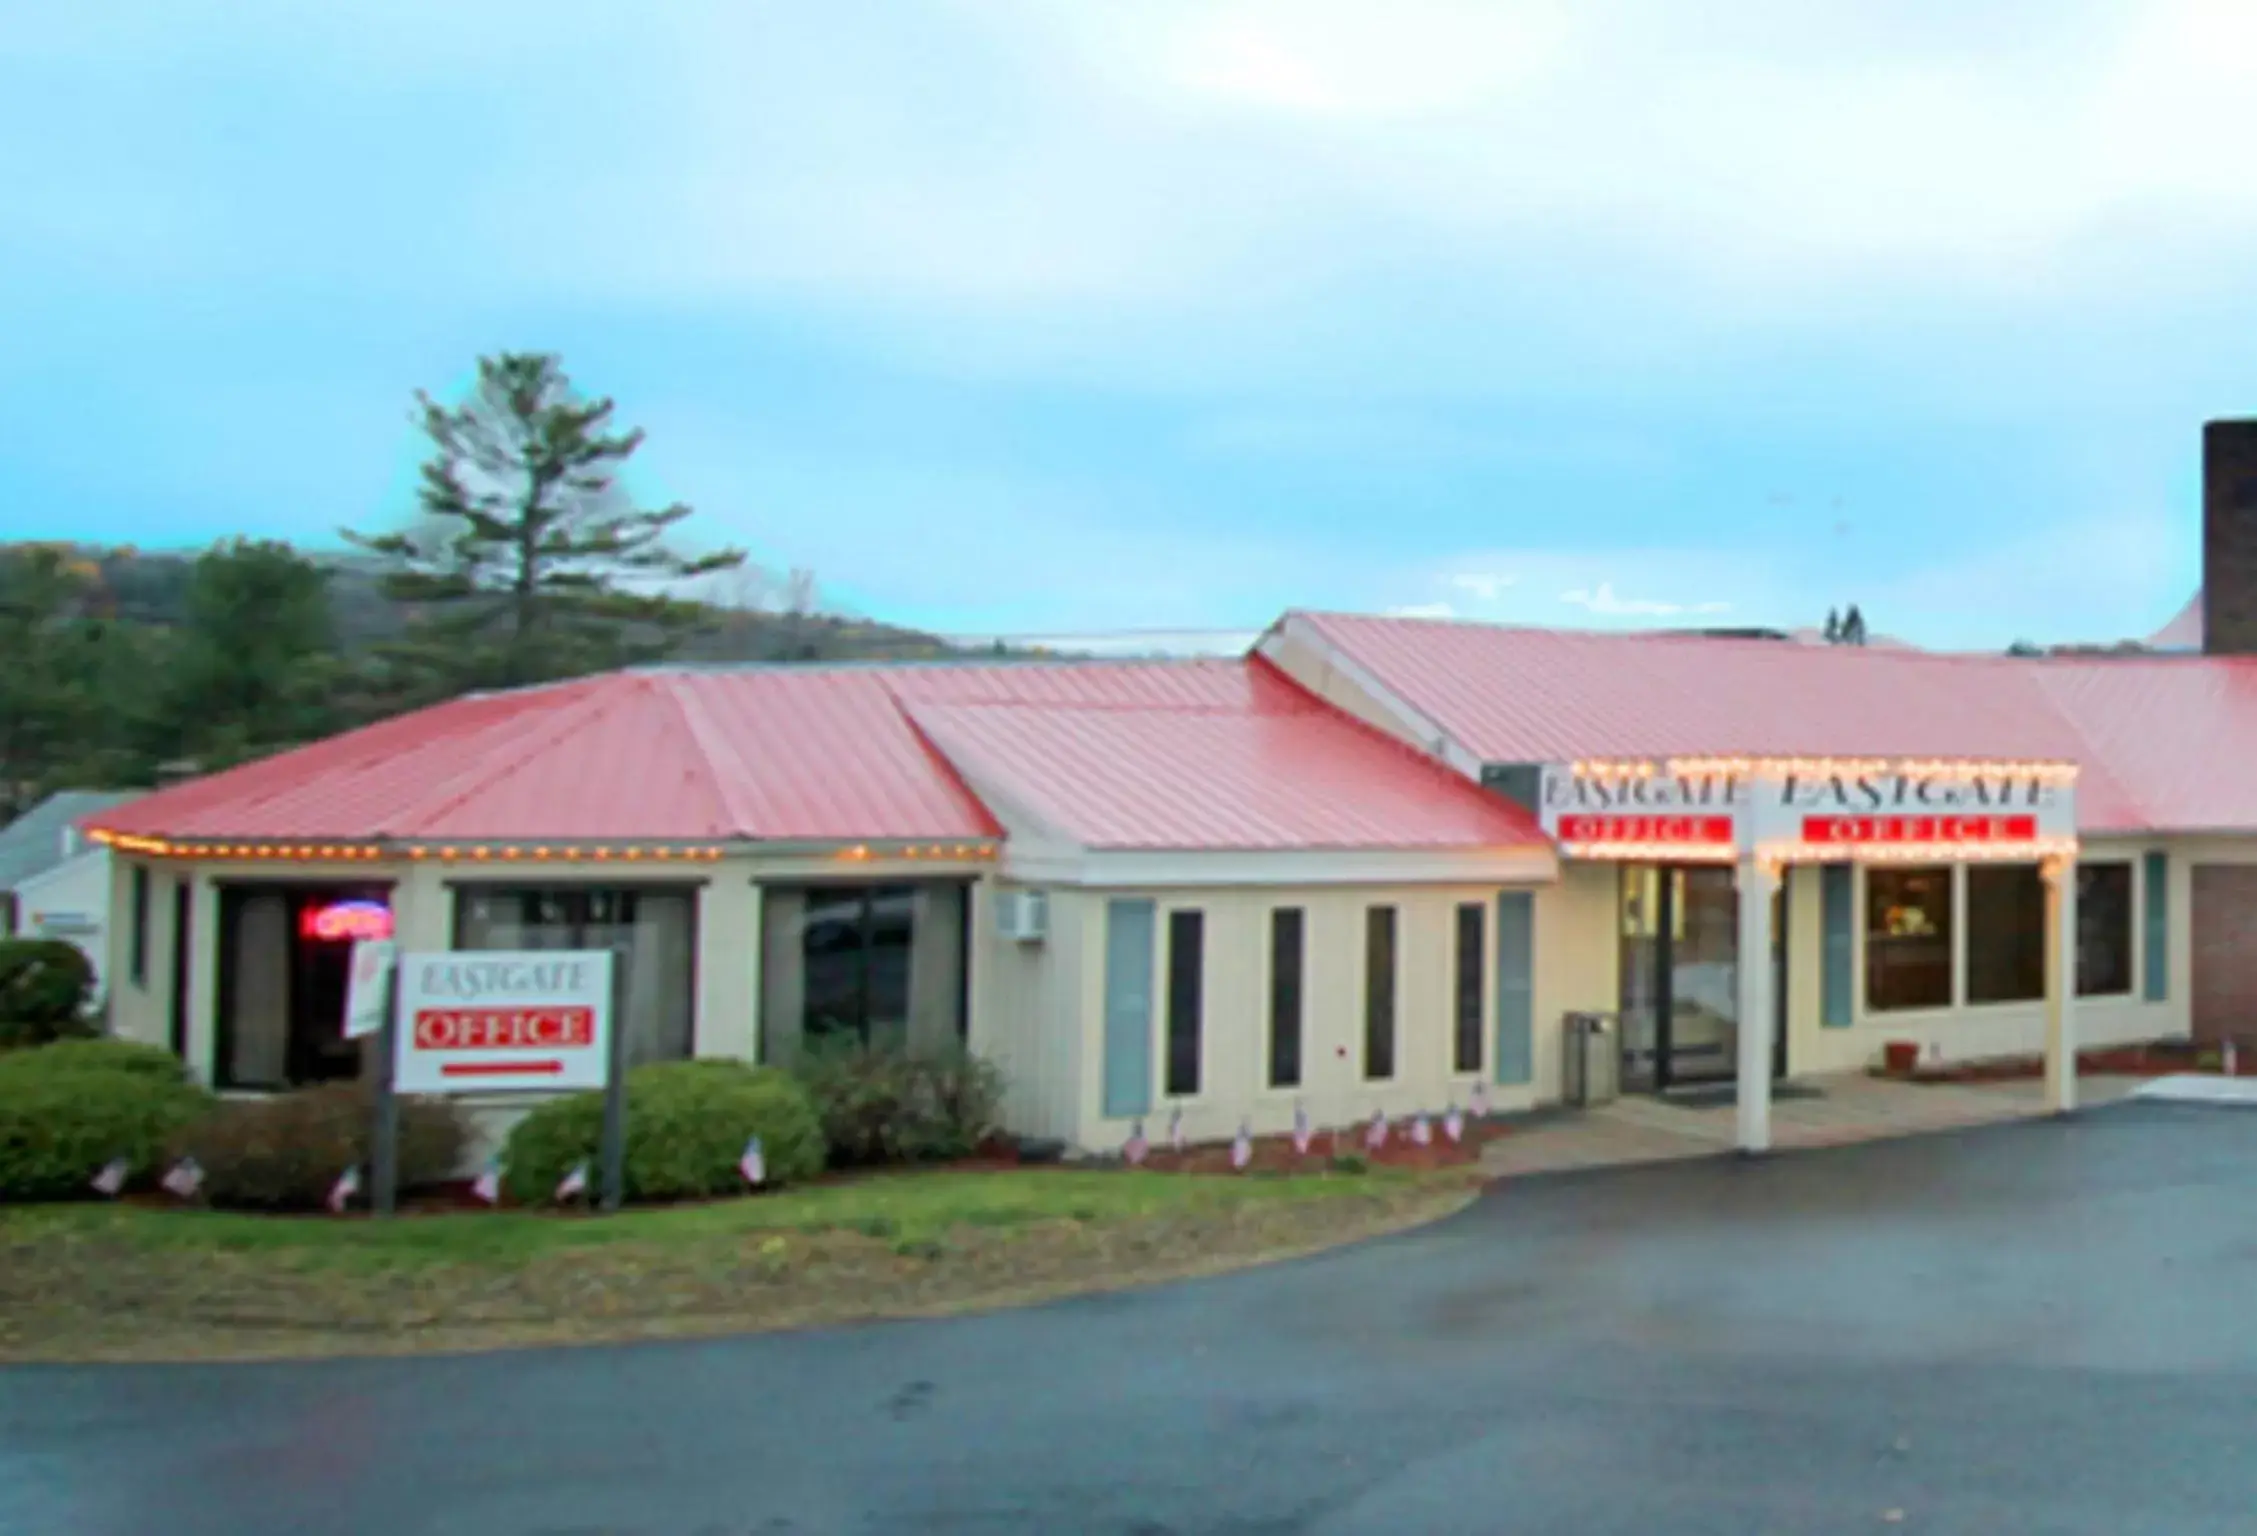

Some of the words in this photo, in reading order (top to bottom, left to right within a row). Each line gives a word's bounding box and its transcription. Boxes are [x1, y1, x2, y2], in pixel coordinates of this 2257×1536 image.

[1545, 770, 1751, 808] EASTGATE
[1779, 770, 2056, 813] EASTGATE
[1572, 816, 1707, 839] OFFICE
[1829, 817, 2008, 840] OFFICE
[420, 962, 586, 999] EASTGATE
[418, 1013, 587, 1046] OFFICE
